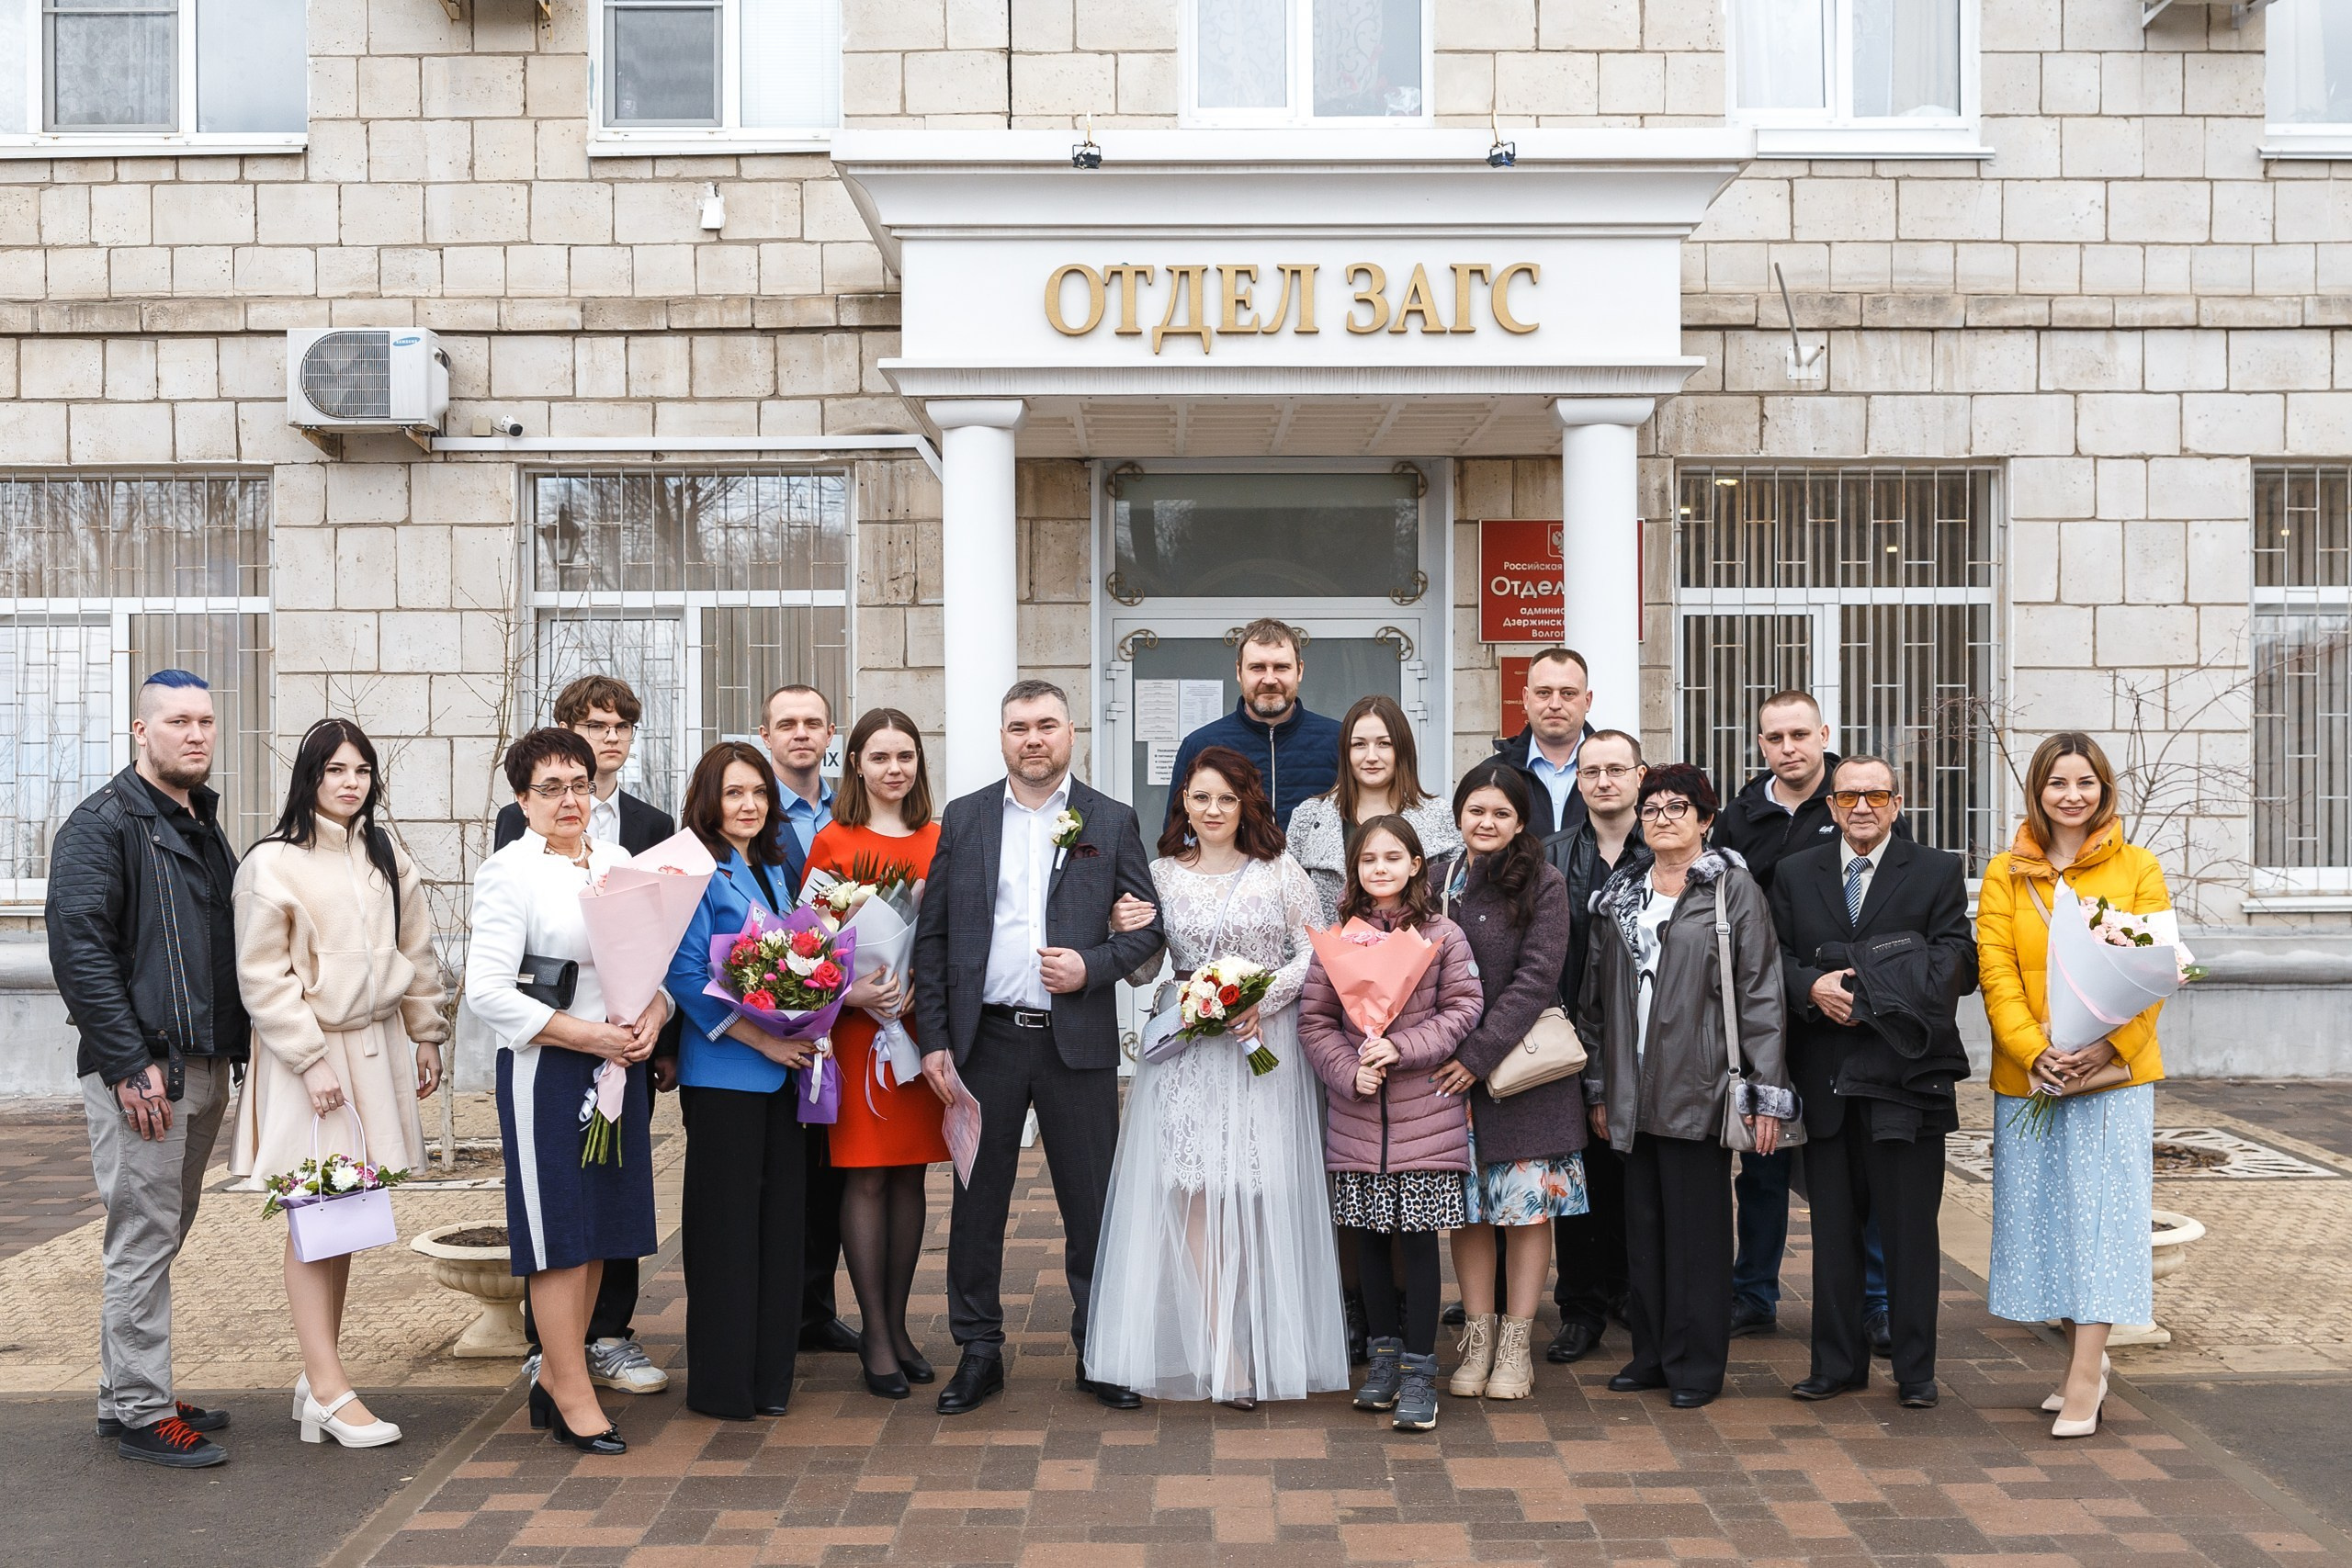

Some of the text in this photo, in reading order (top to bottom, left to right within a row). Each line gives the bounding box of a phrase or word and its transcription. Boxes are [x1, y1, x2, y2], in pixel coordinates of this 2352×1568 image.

[1044, 263, 1541, 355] ОТДЕЛ ЗАГС
[1503, 561, 1563, 570] Российская
[1490, 576, 1565, 599] Отдел
